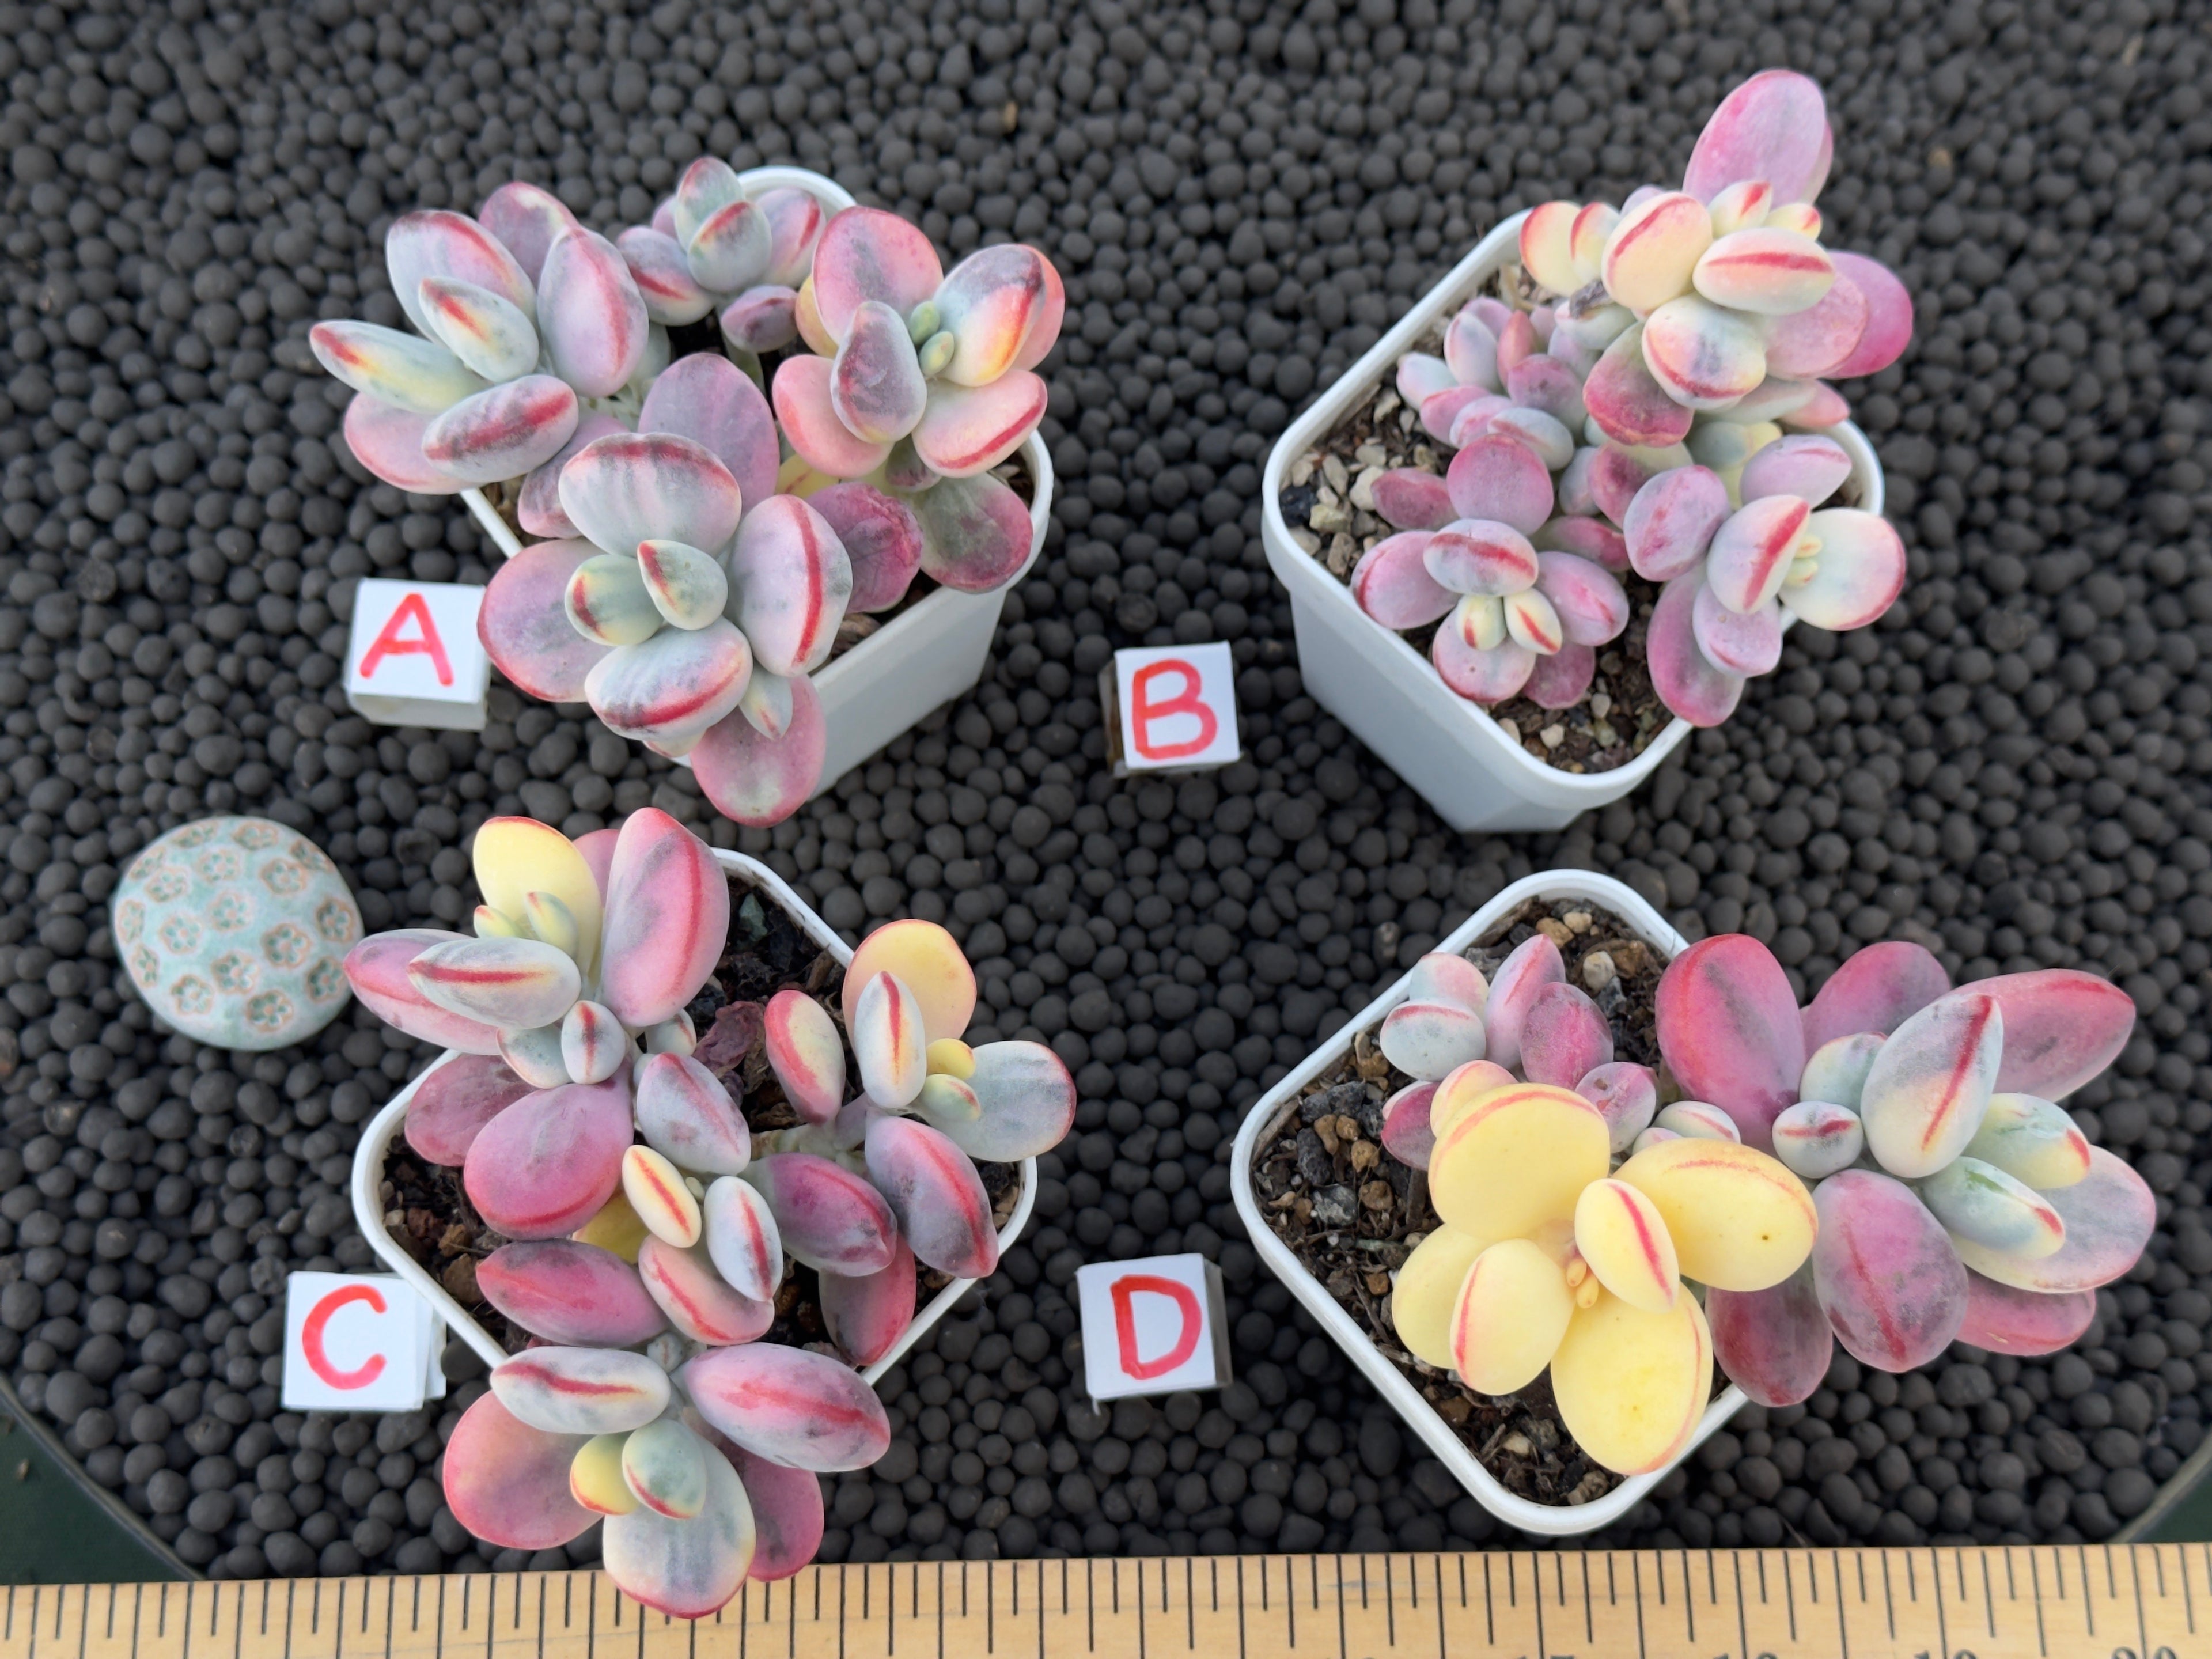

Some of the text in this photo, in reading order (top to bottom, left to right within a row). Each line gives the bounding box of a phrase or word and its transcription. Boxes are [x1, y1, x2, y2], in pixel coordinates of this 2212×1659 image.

[360, 593, 453, 686] A
[1132, 660, 1217, 760] B
[302, 1285, 386, 1389] C
[1111, 1275, 1201, 1380] D
